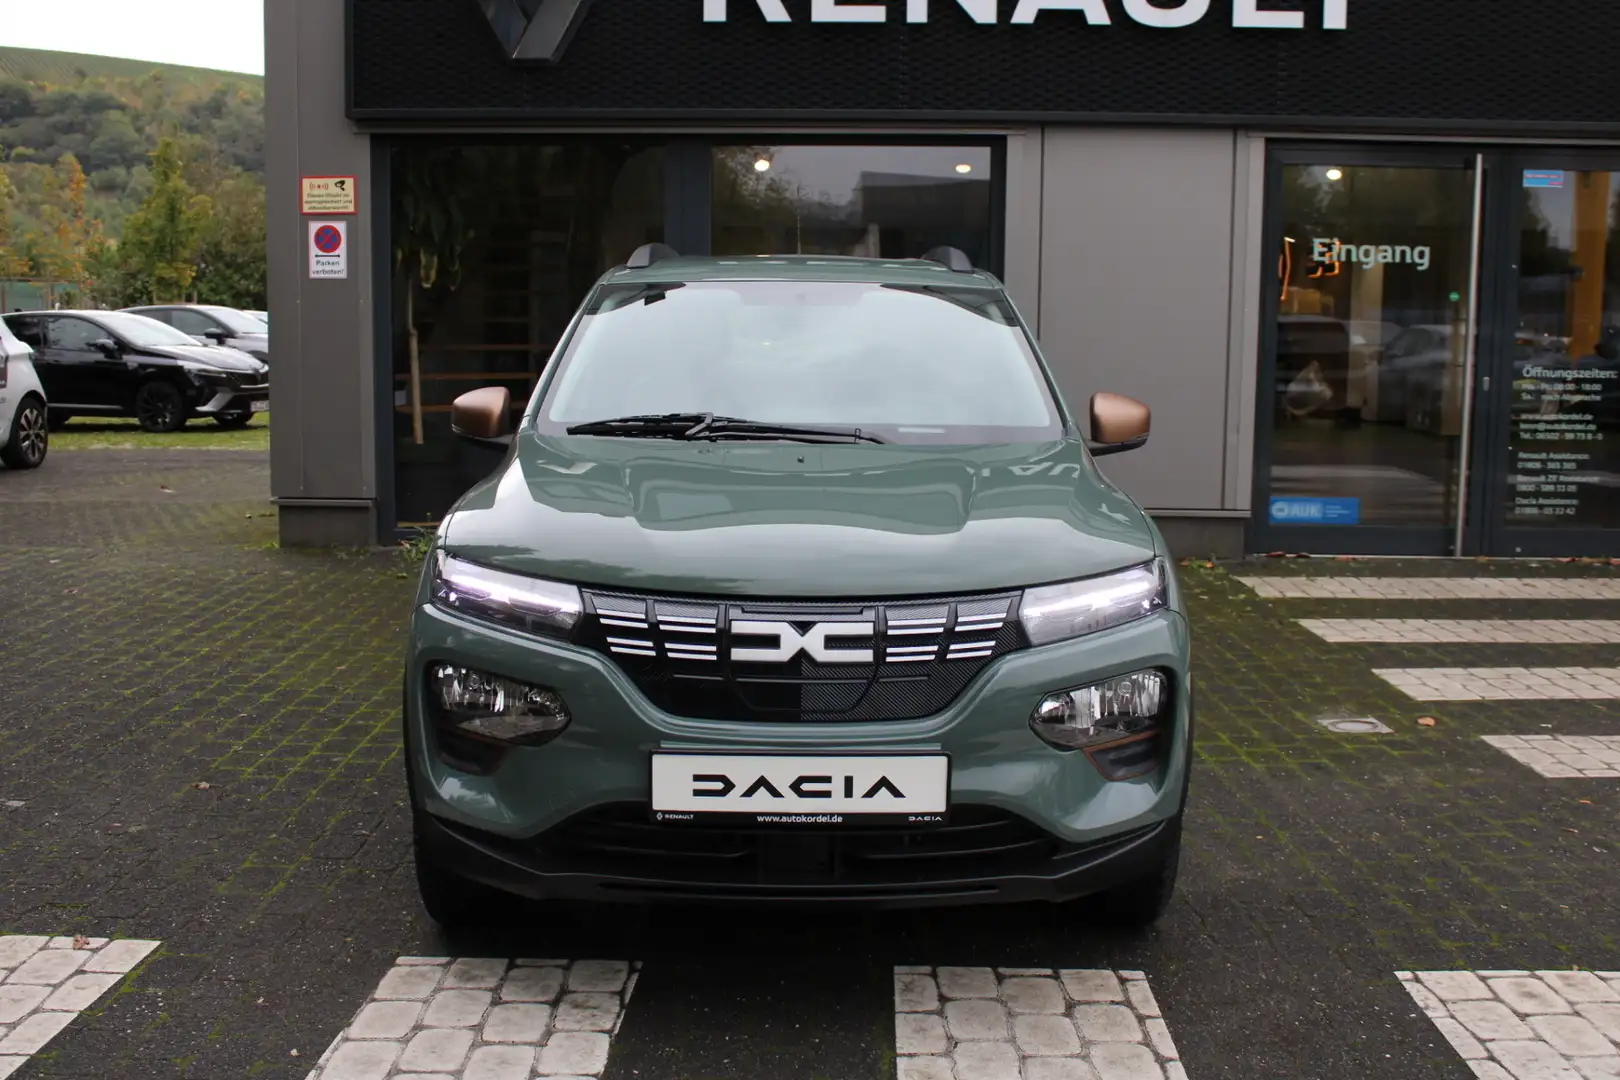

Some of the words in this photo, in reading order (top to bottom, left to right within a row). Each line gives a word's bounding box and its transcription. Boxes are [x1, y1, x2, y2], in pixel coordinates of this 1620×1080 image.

[1312, 238, 1431, 271] Eingang
[315, 259, 340, 267] Parken
[312, 268, 345, 276] verboten!
[1522, 364, 1618, 381] Öffnungszeiten:
[692, 773, 907, 799] DACIA
[664, 813, 694, 821] RENAULT
[756, 813, 843, 824] www.autokordel.de
